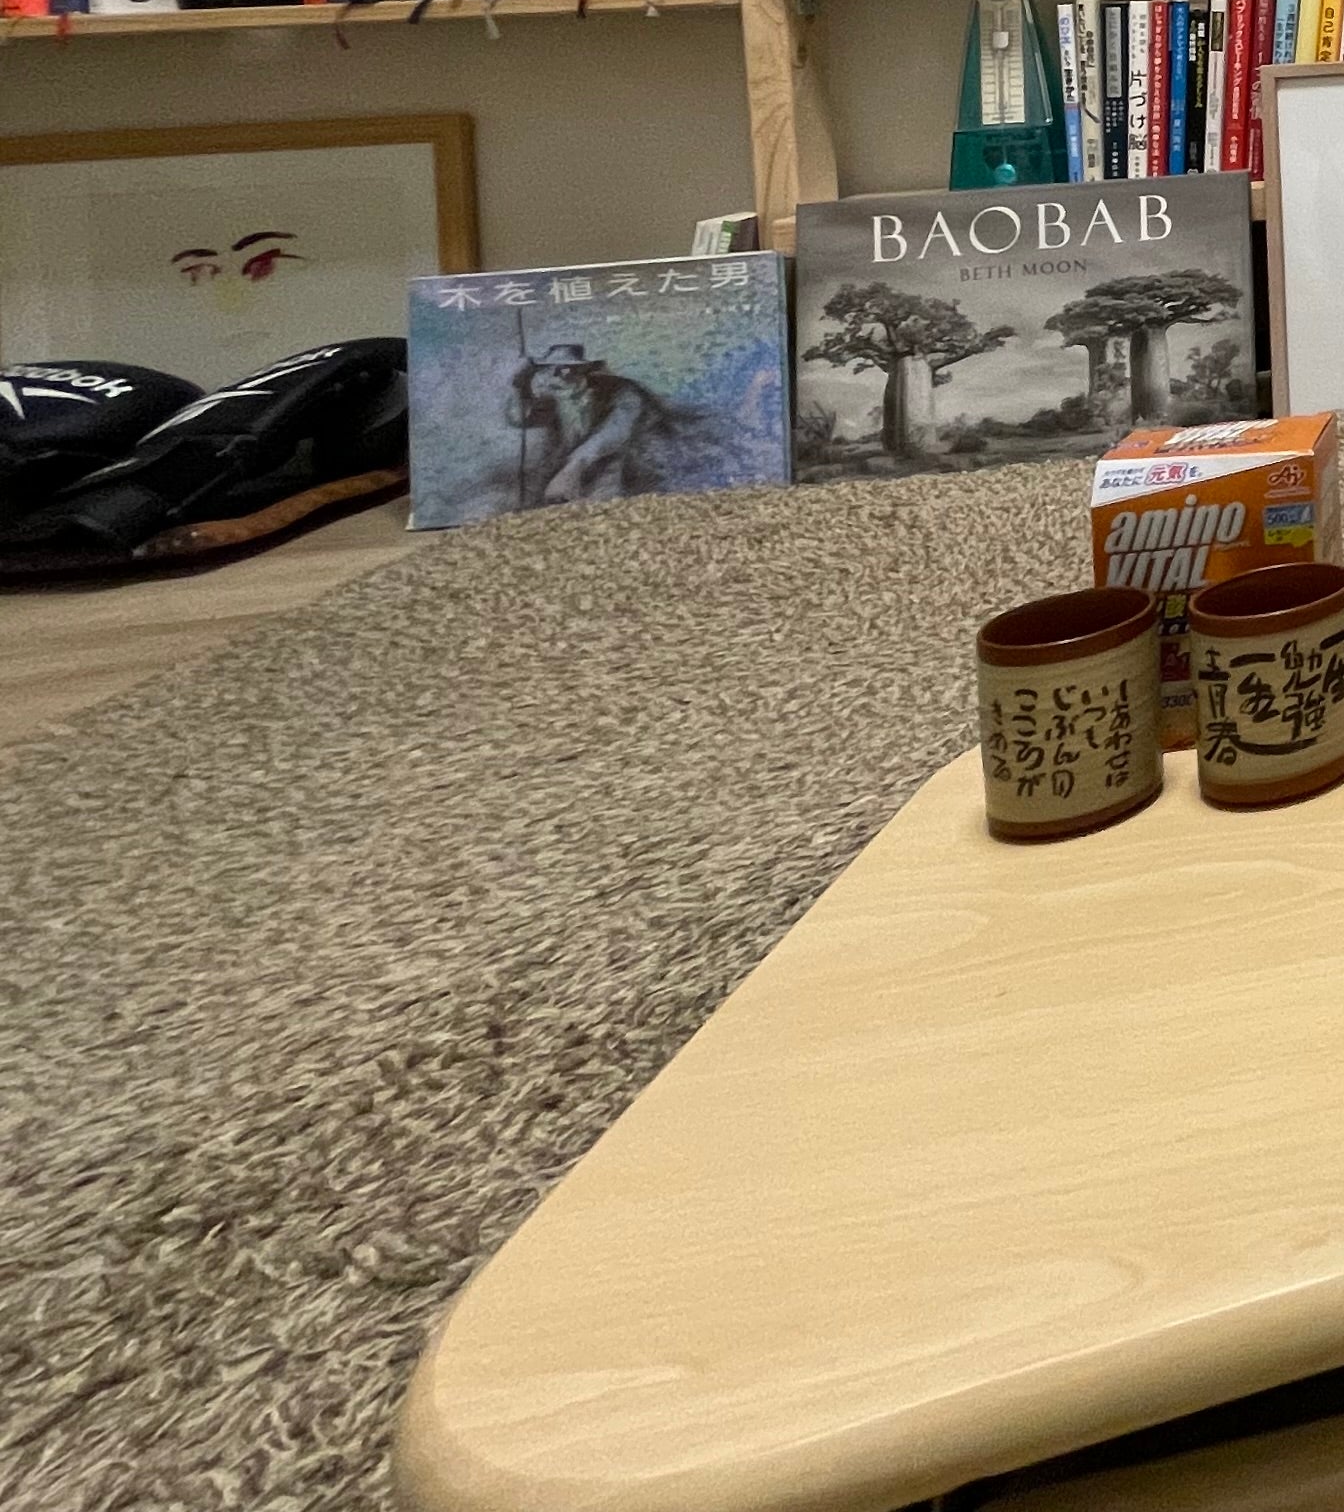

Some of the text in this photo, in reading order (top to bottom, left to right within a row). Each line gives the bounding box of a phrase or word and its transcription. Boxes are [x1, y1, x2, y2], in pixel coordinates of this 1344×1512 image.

[1128, 69, 1148, 151] 片づけ脳
[870, 193, 1174, 264] BAOBAB
[437, 260, 752, 313] 木を植えた男
[959, 259, 1088, 283] BETH MOON
[1104, 493, 1247, 554] amino
[1106, 544, 1210, 592] VITAL
[1081, 685, 1110, 750] いつも
[1279, 639, 1329, 740] 勉強
[1011, 688, 1047, 798] こころが
[1045, 685, 1082, 799] じぶんの
[1104, 678, 1133, 789] しあわせは
